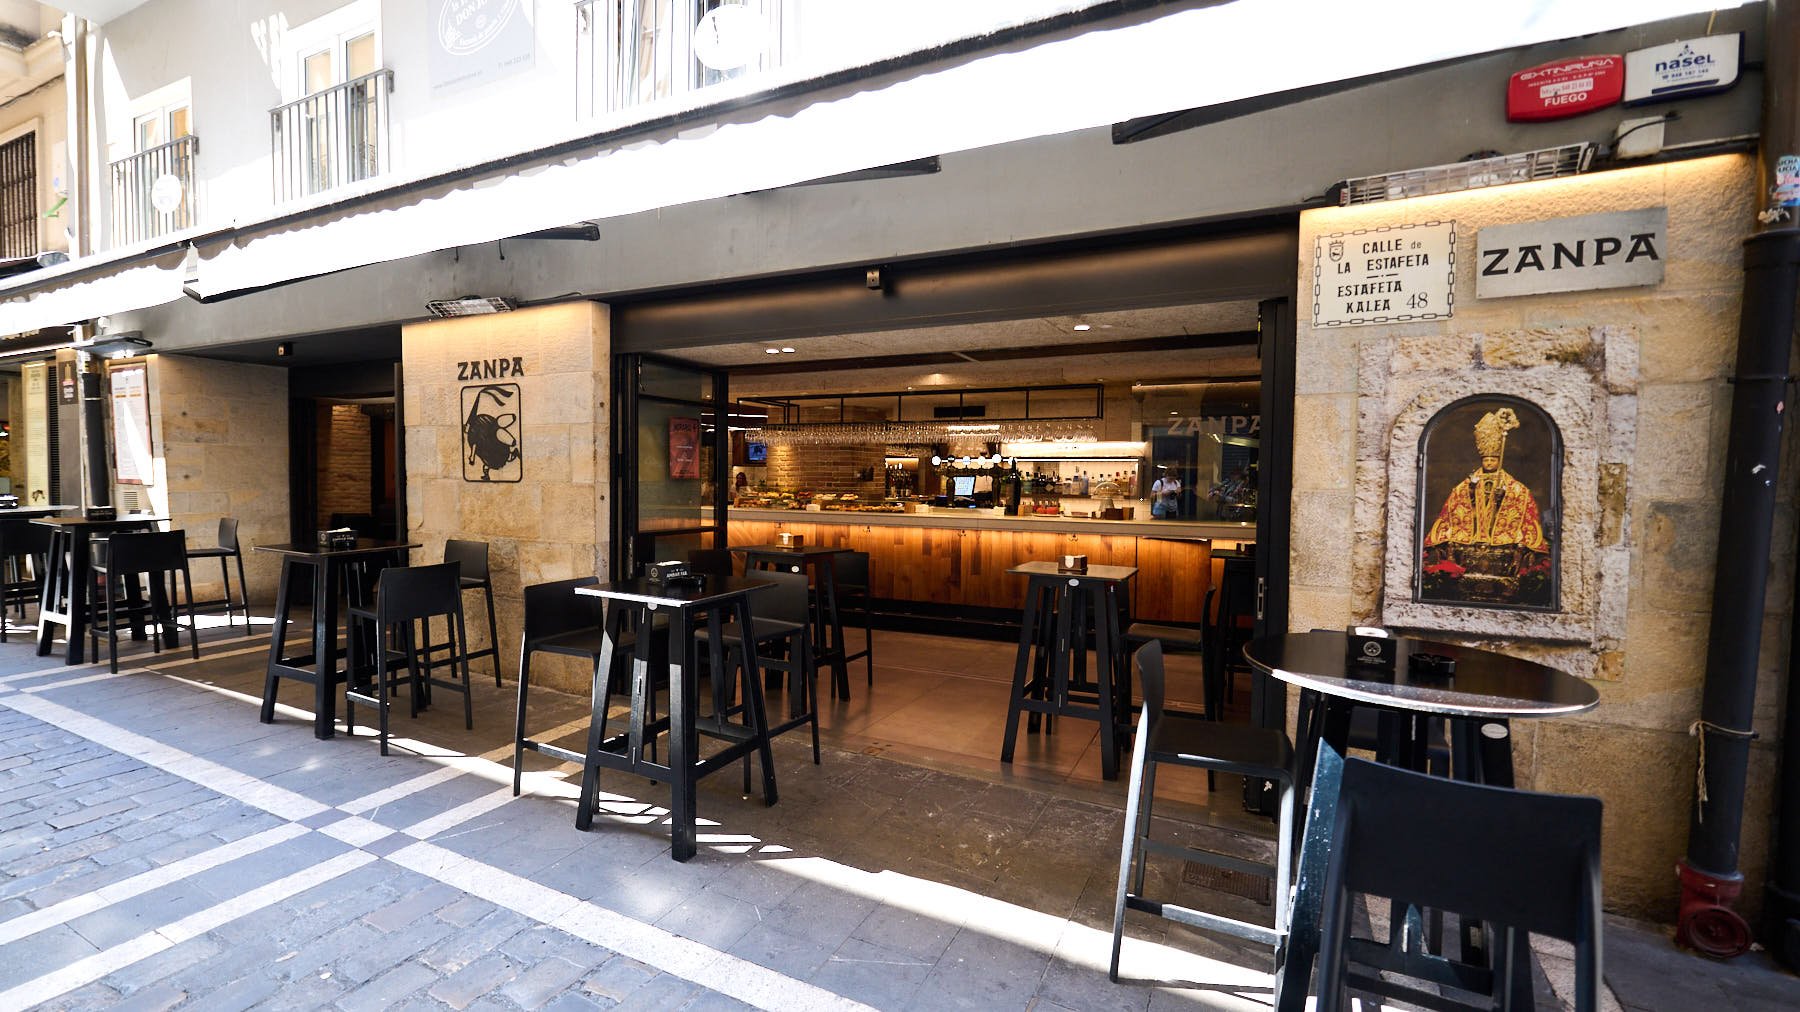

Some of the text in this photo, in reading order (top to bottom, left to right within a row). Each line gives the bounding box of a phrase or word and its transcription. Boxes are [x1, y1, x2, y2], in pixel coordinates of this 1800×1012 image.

[1655, 54, 1714, 72] nasel
[1544, 92, 1587, 107] FUEGO
[1362, 238, 1422, 255] CALLE de
[1481, 232, 1660, 277] ZANPA
[1337, 253, 1429, 275] LA ESTAFETA
[1337, 280, 1402, 298] ESTAFETA
[1346, 292, 1428, 314] KALEA 48
[457, 356, 524, 381] ZANPA
[1167, 415, 1260, 436] ZANPA
